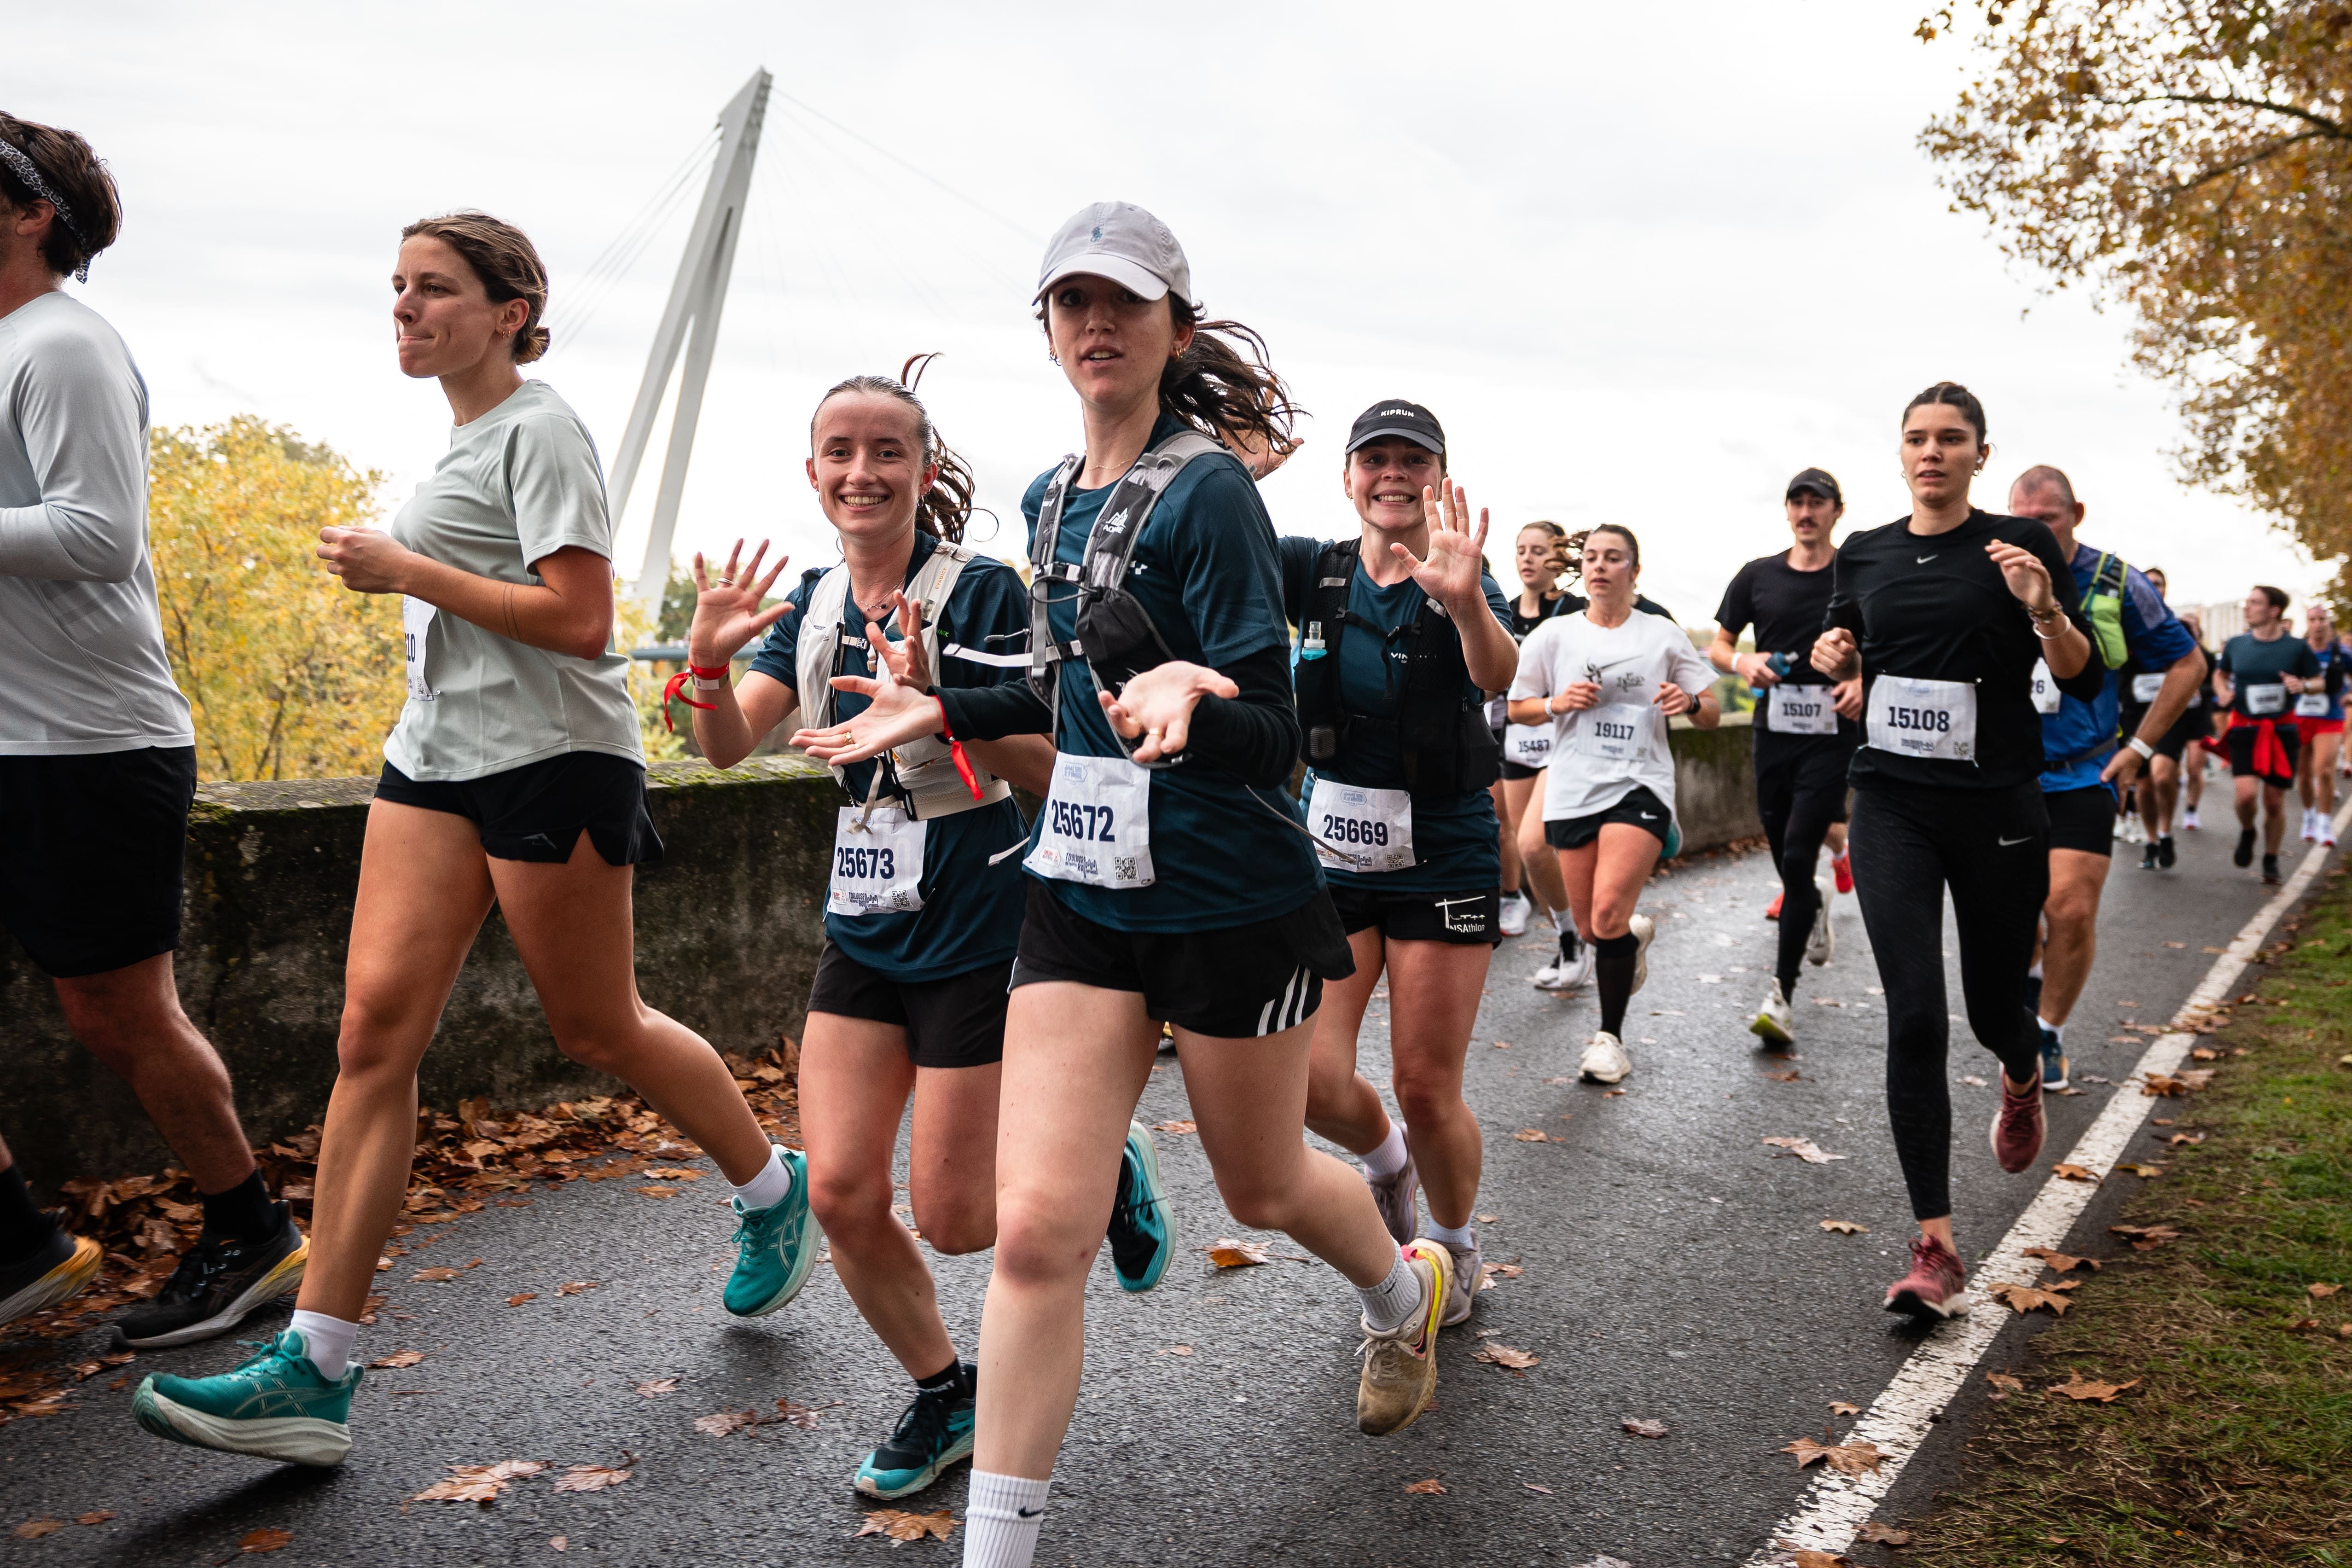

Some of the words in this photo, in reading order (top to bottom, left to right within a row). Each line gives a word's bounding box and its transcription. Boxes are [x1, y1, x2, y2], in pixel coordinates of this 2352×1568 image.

[1381, 409, 1414, 417] KIPRUN
[935, 568, 947, 589] EVADICT
[1783, 703, 1821, 717] 15107
[1888, 706, 1950, 732] 15108
[1595, 722, 1634, 740] 19117
[1519, 739, 1550, 753] 15487
[1051, 799, 1115, 842] 25672
[1323, 814, 1388, 846] 25669
[837, 847, 895, 879] 25673
